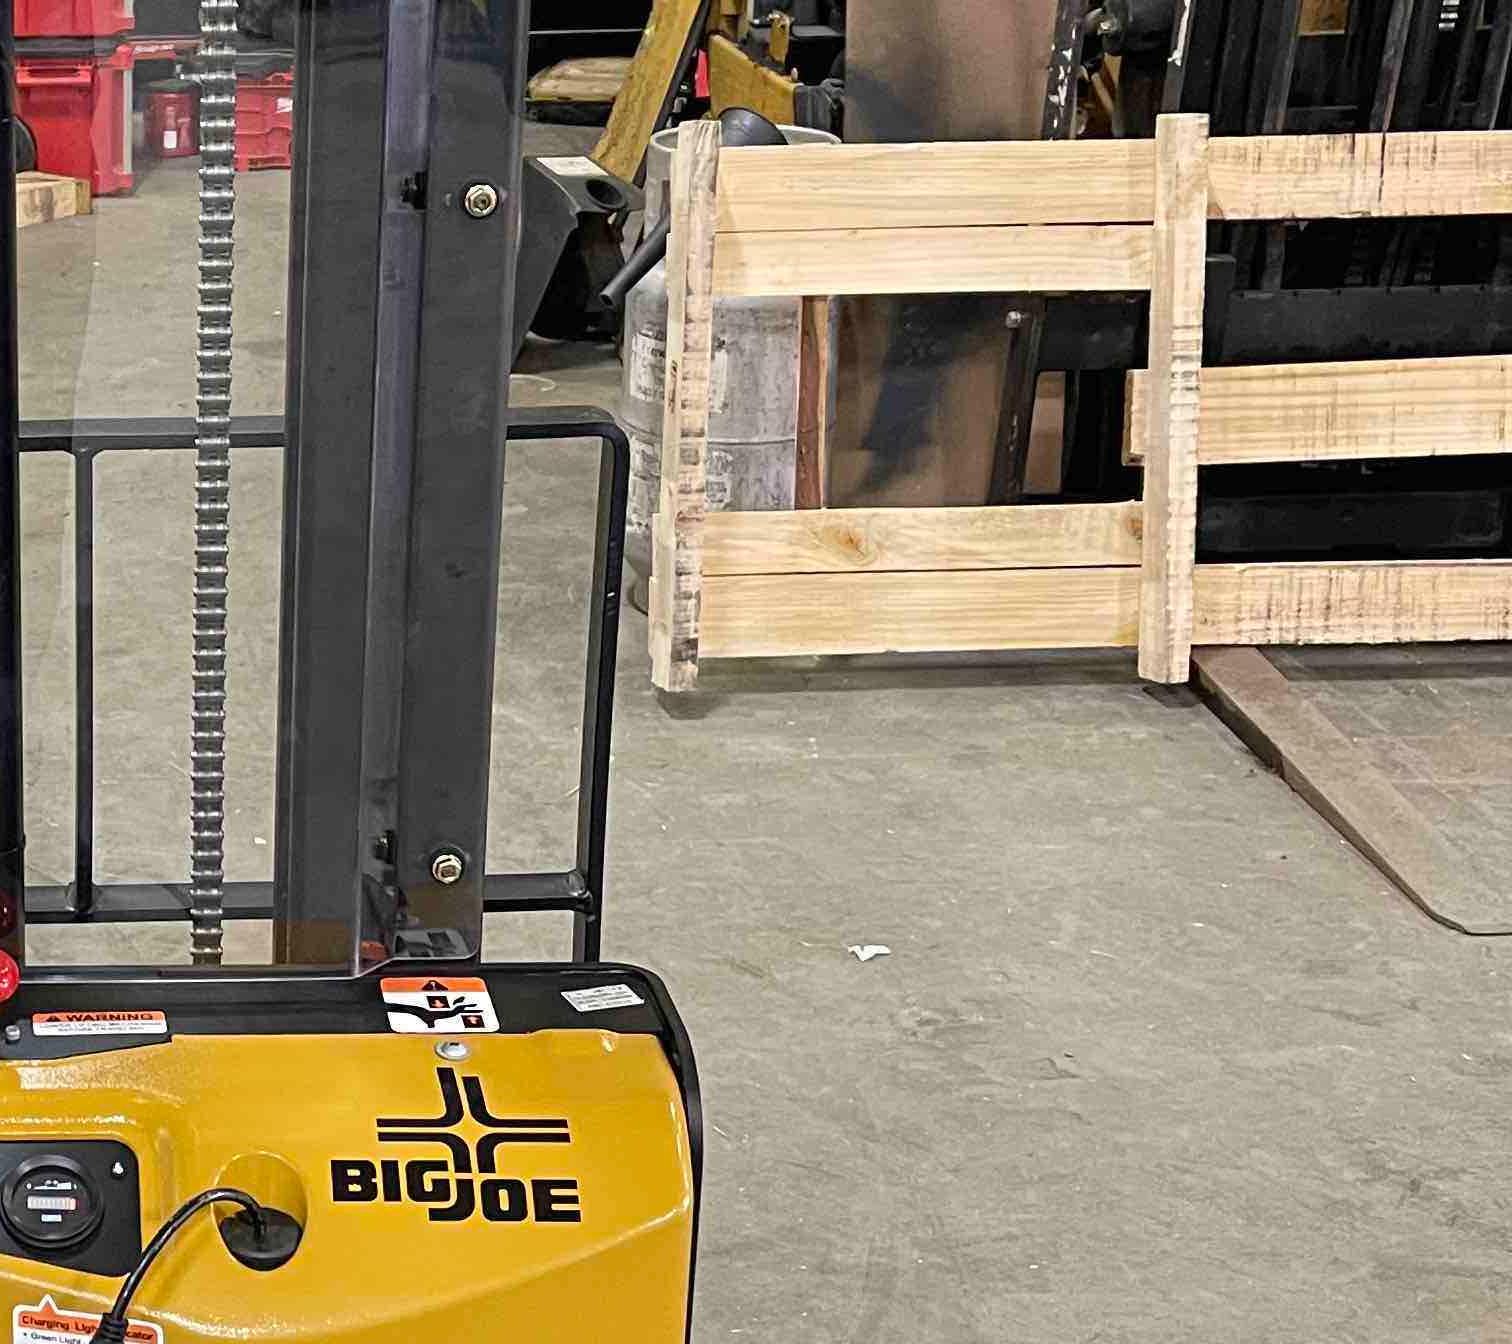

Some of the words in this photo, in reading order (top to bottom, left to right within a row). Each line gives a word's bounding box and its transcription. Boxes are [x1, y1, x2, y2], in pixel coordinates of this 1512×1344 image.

[65, 1012, 153, 1022] WARNING
[330, 1159, 453, 1203] BIG
[428, 1178, 581, 1222] JOE
[22, 1315, 70, 1331] Charging
[75, 1320, 97, 1334] Ligh
